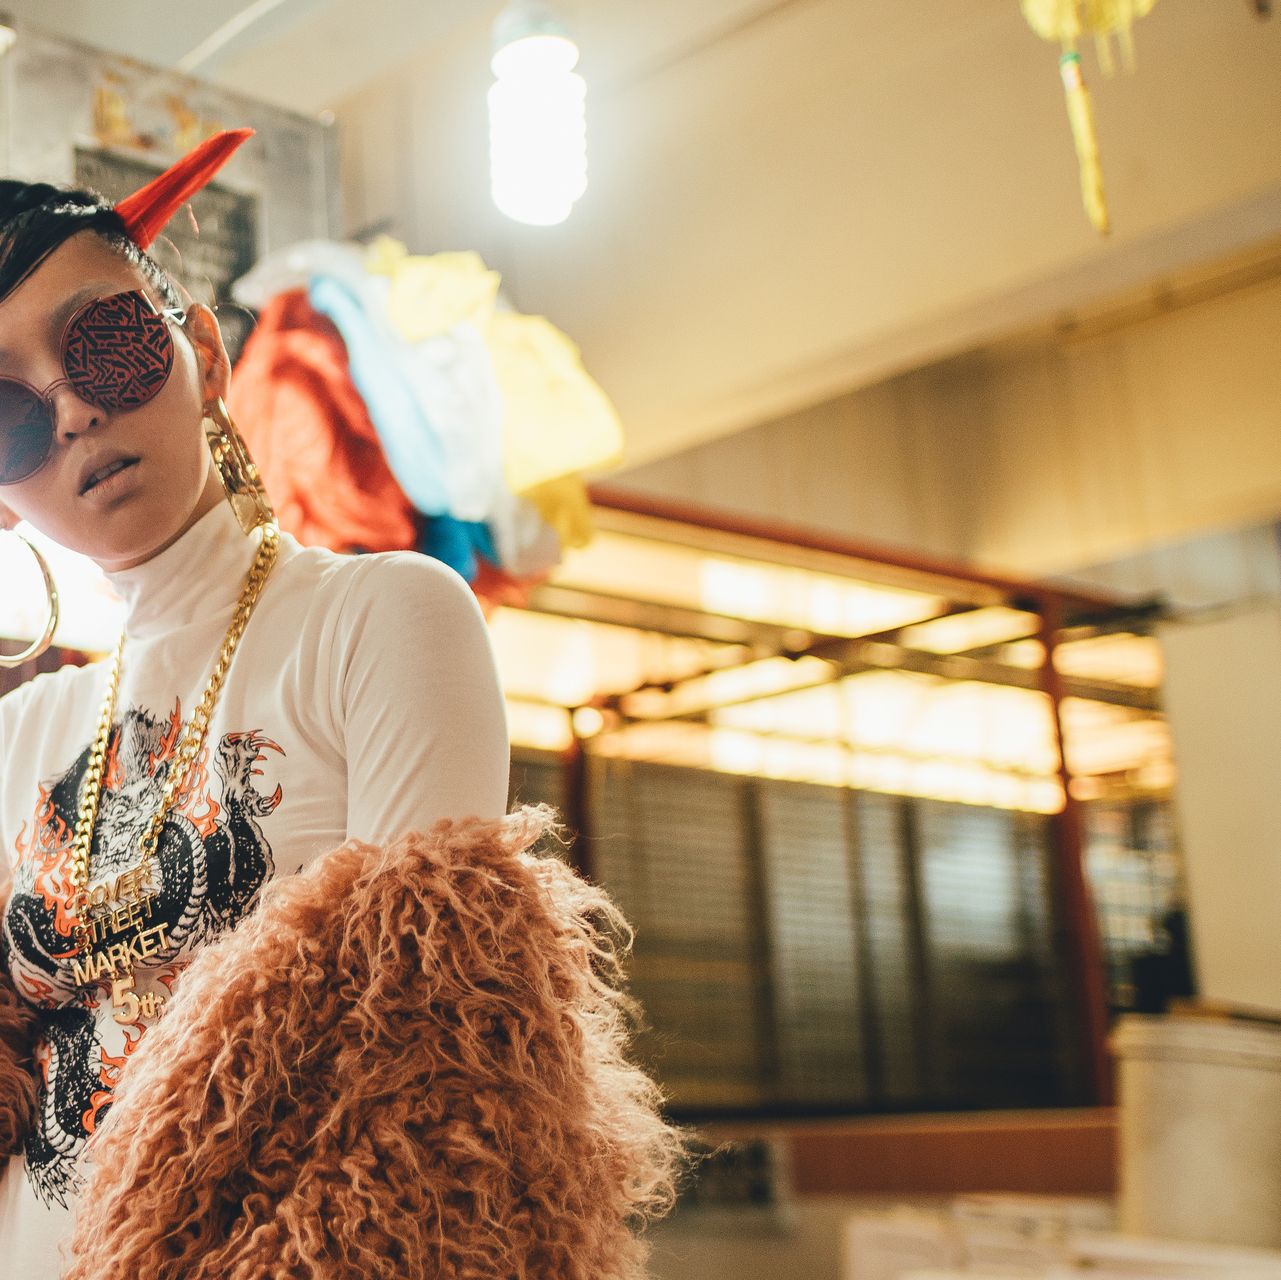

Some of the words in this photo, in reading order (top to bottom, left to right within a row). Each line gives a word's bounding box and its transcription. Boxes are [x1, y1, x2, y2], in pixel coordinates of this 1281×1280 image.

[73, 863, 154, 918] DOVER
[73, 894, 156, 950] STREET
[72, 922, 170, 987] MARKET
[111, 976, 166, 1026] 5th
